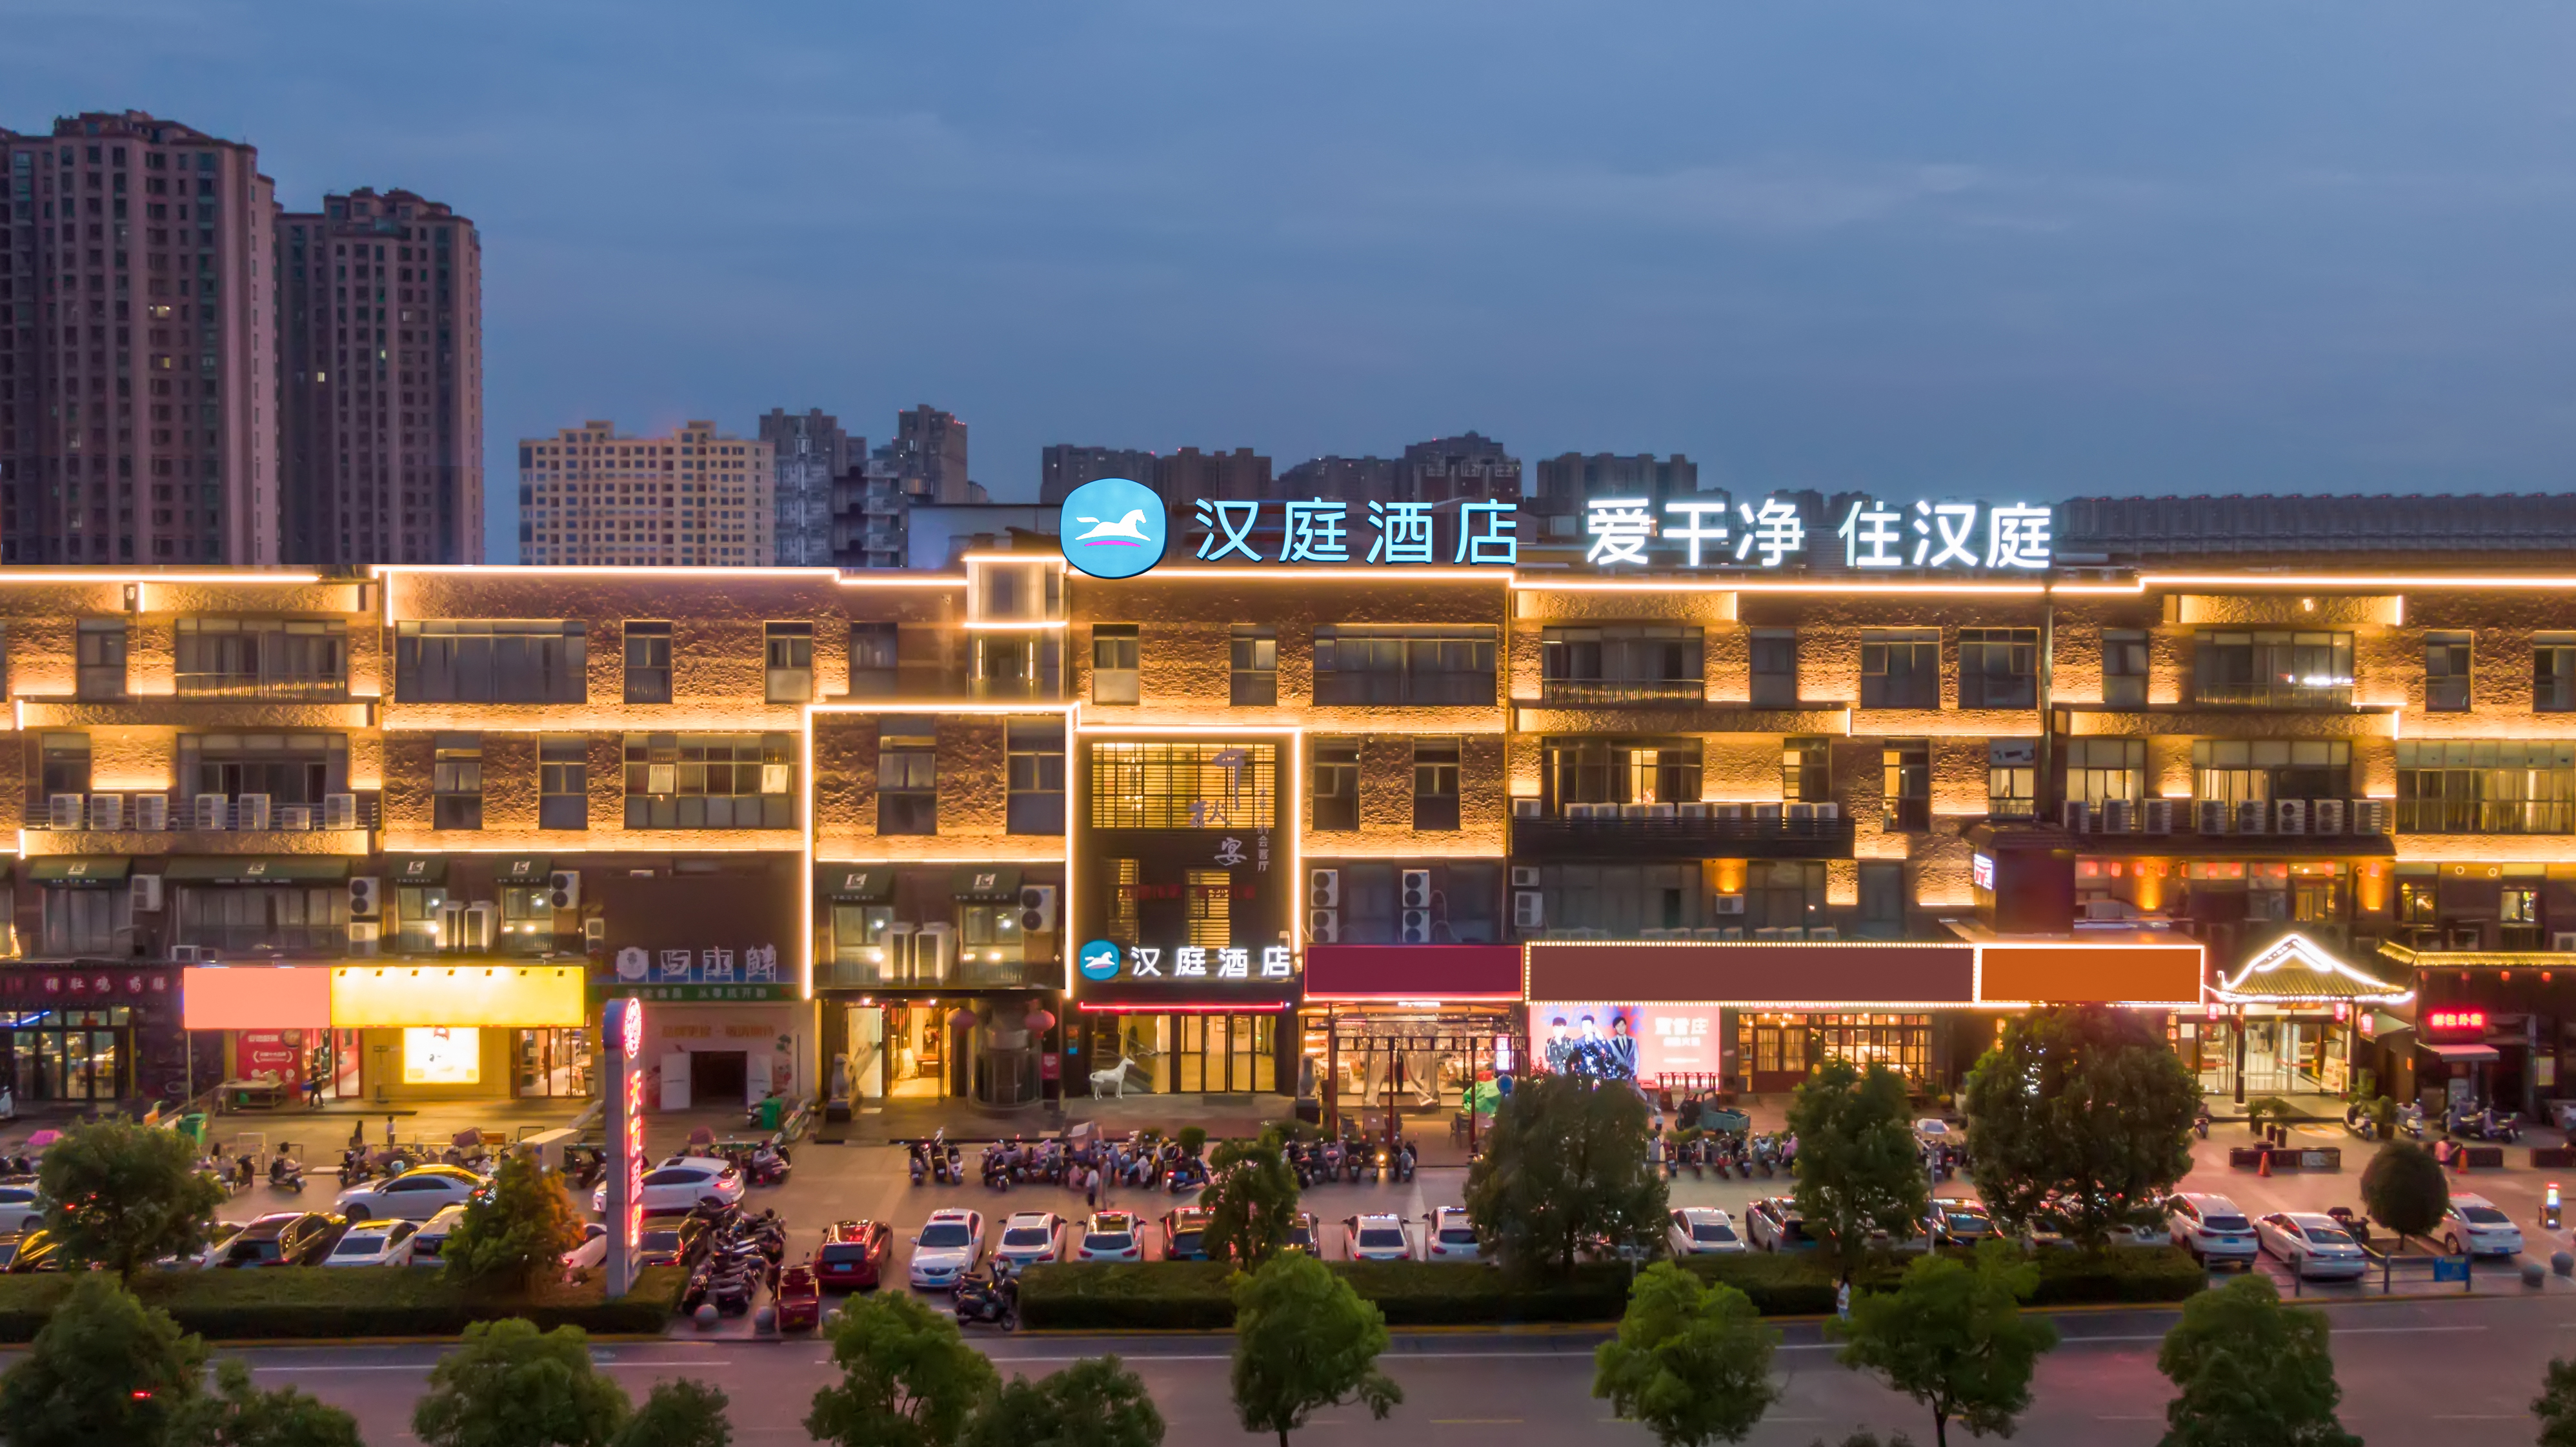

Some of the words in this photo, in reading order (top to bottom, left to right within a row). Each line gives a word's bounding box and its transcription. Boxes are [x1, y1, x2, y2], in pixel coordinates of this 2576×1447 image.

[1194, 496, 1518, 565] 汉庭酒店
[1587, 498, 1805, 567] 爱干净
[1837, 500, 2051, 569] 住汉庭
[1131, 946, 1291, 978] 汉庭酒店
